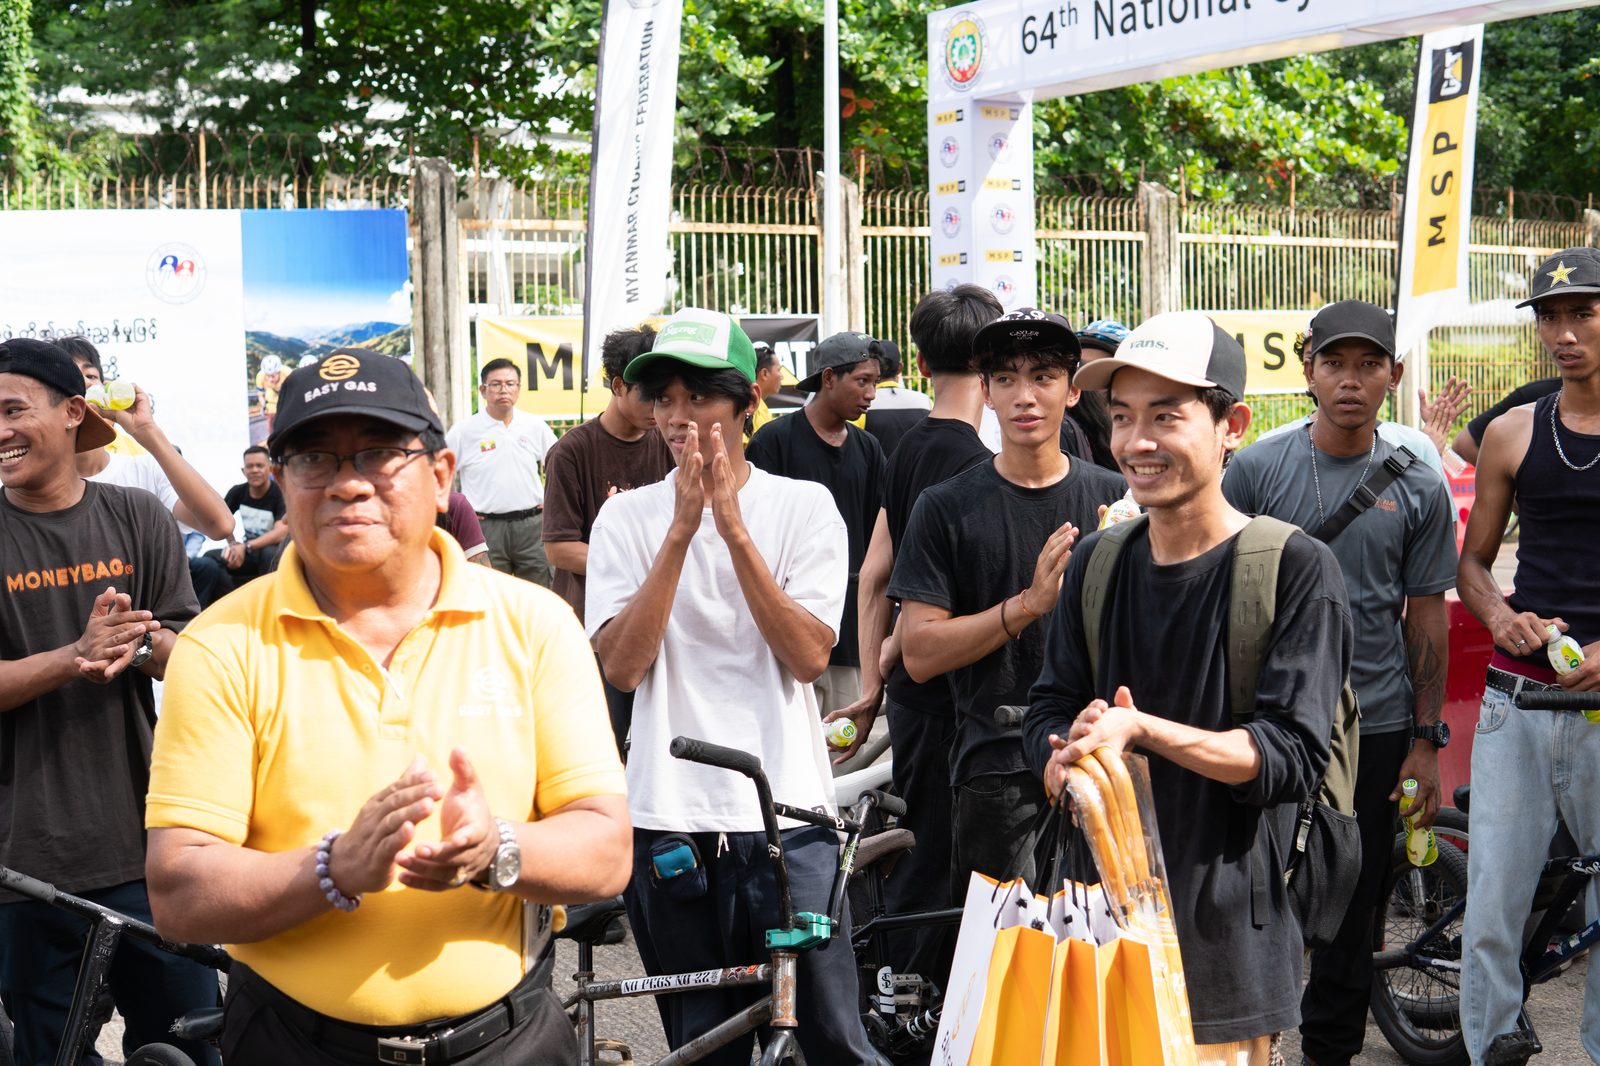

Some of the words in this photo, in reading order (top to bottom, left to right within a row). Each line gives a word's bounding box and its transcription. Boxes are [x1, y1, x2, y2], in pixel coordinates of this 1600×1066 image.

[1022, 2, 1078, 54] 64th
[1094, 0, 1251, 40] Nationa
[626, 210, 639, 304] MYANMAR
[636, 20, 654, 126] FEDERATION
[1428, 131, 1458, 247] MSP
[753, 341, 811, 382] AT
[304, 382, 340, 403] EASY
[343, 381, 377, 392] GAS
[641, 976, 673, 991] PEGS
